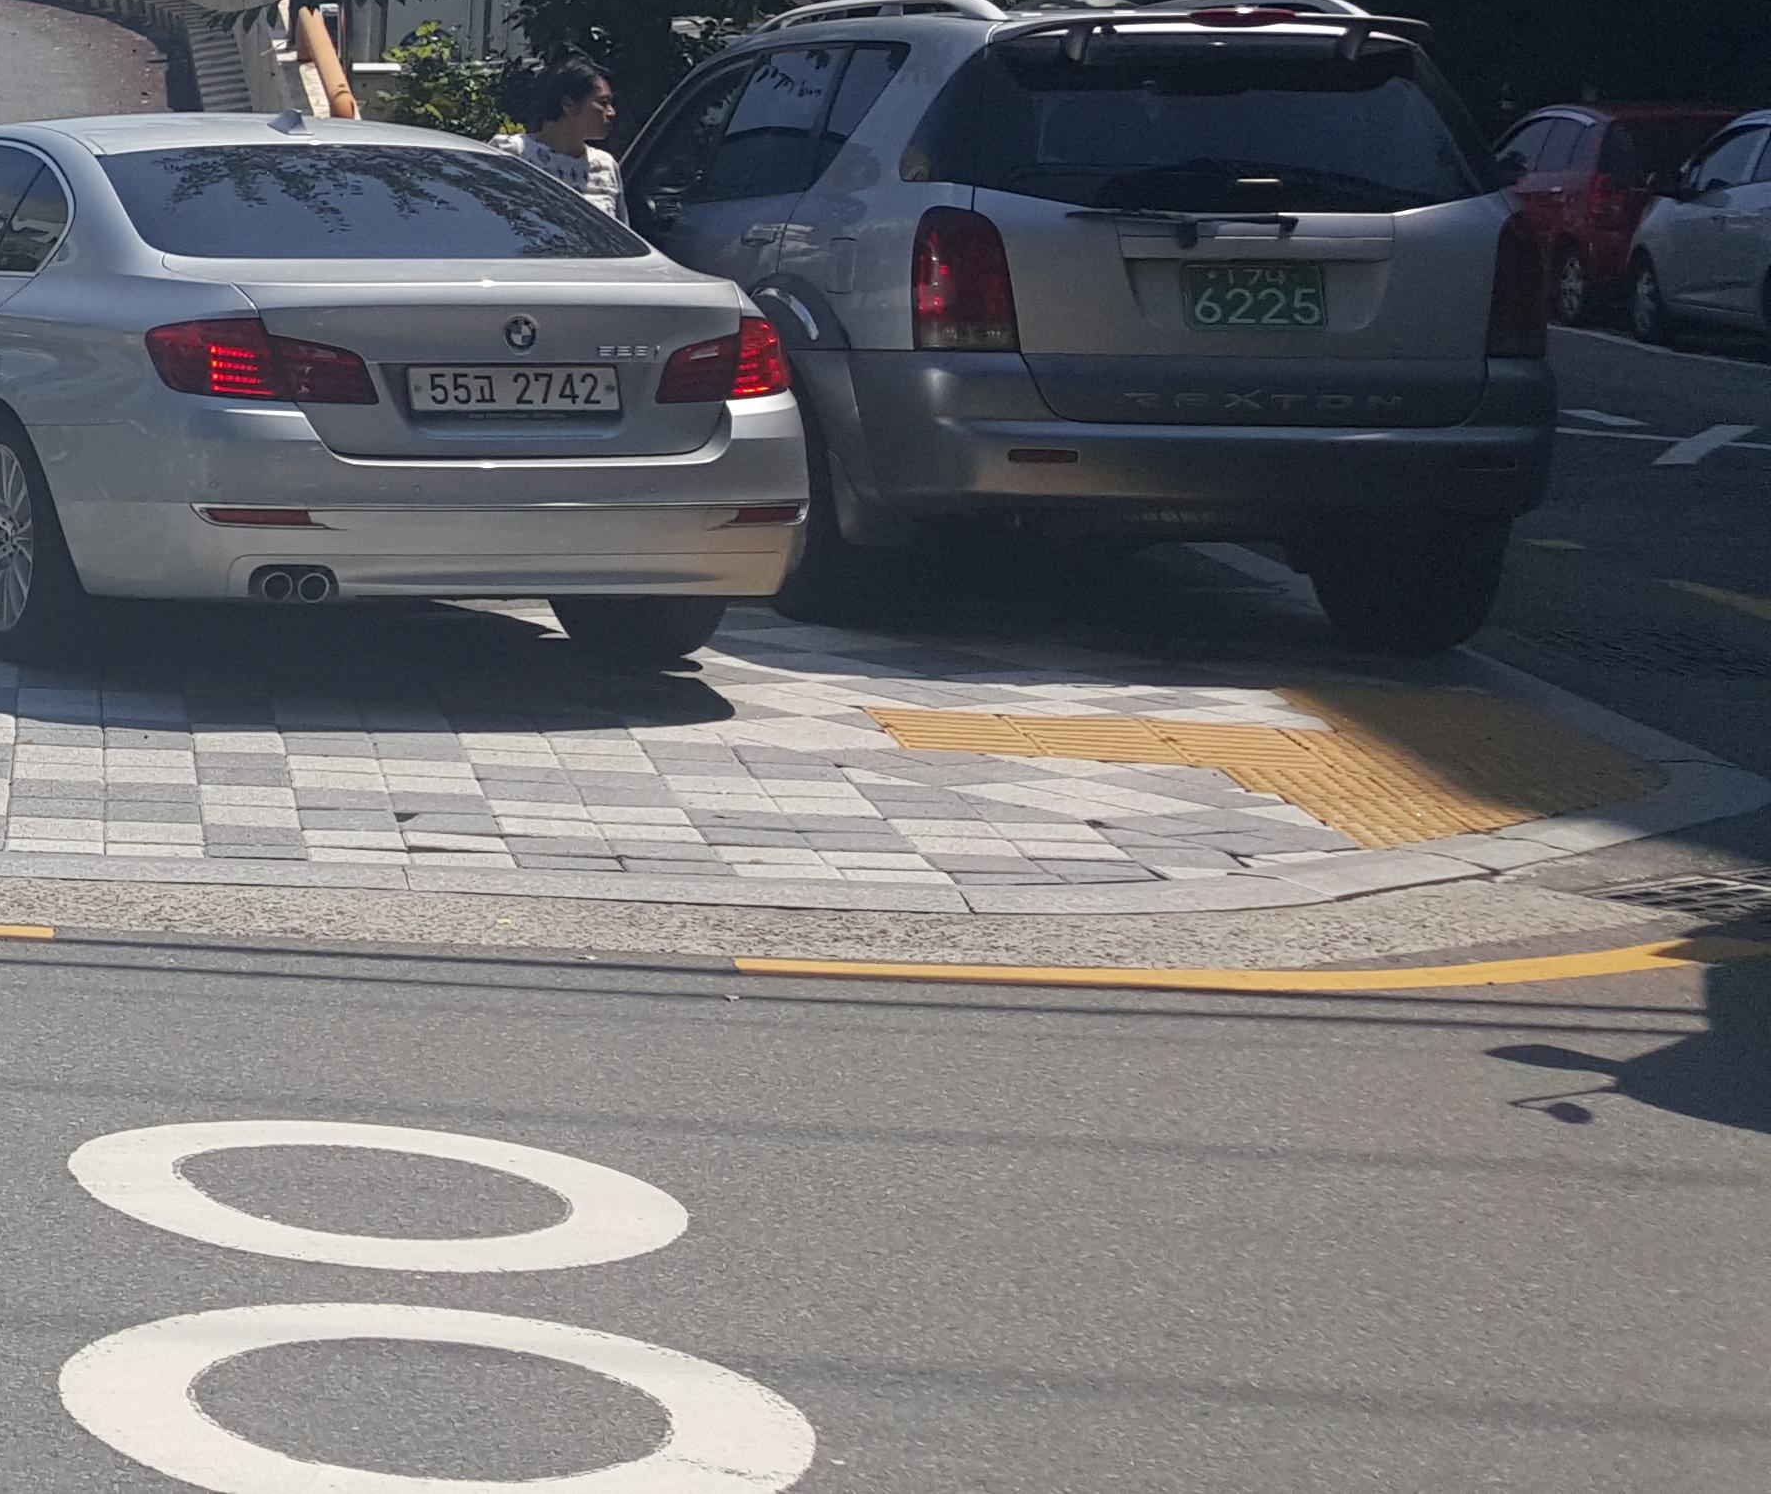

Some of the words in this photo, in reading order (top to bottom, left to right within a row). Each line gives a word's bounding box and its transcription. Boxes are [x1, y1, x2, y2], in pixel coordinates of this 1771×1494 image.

[1195, 288, 1321, 324] 6225
[430, 374, 496, 404] 55고
[513, 373, 601, 404] 2742
